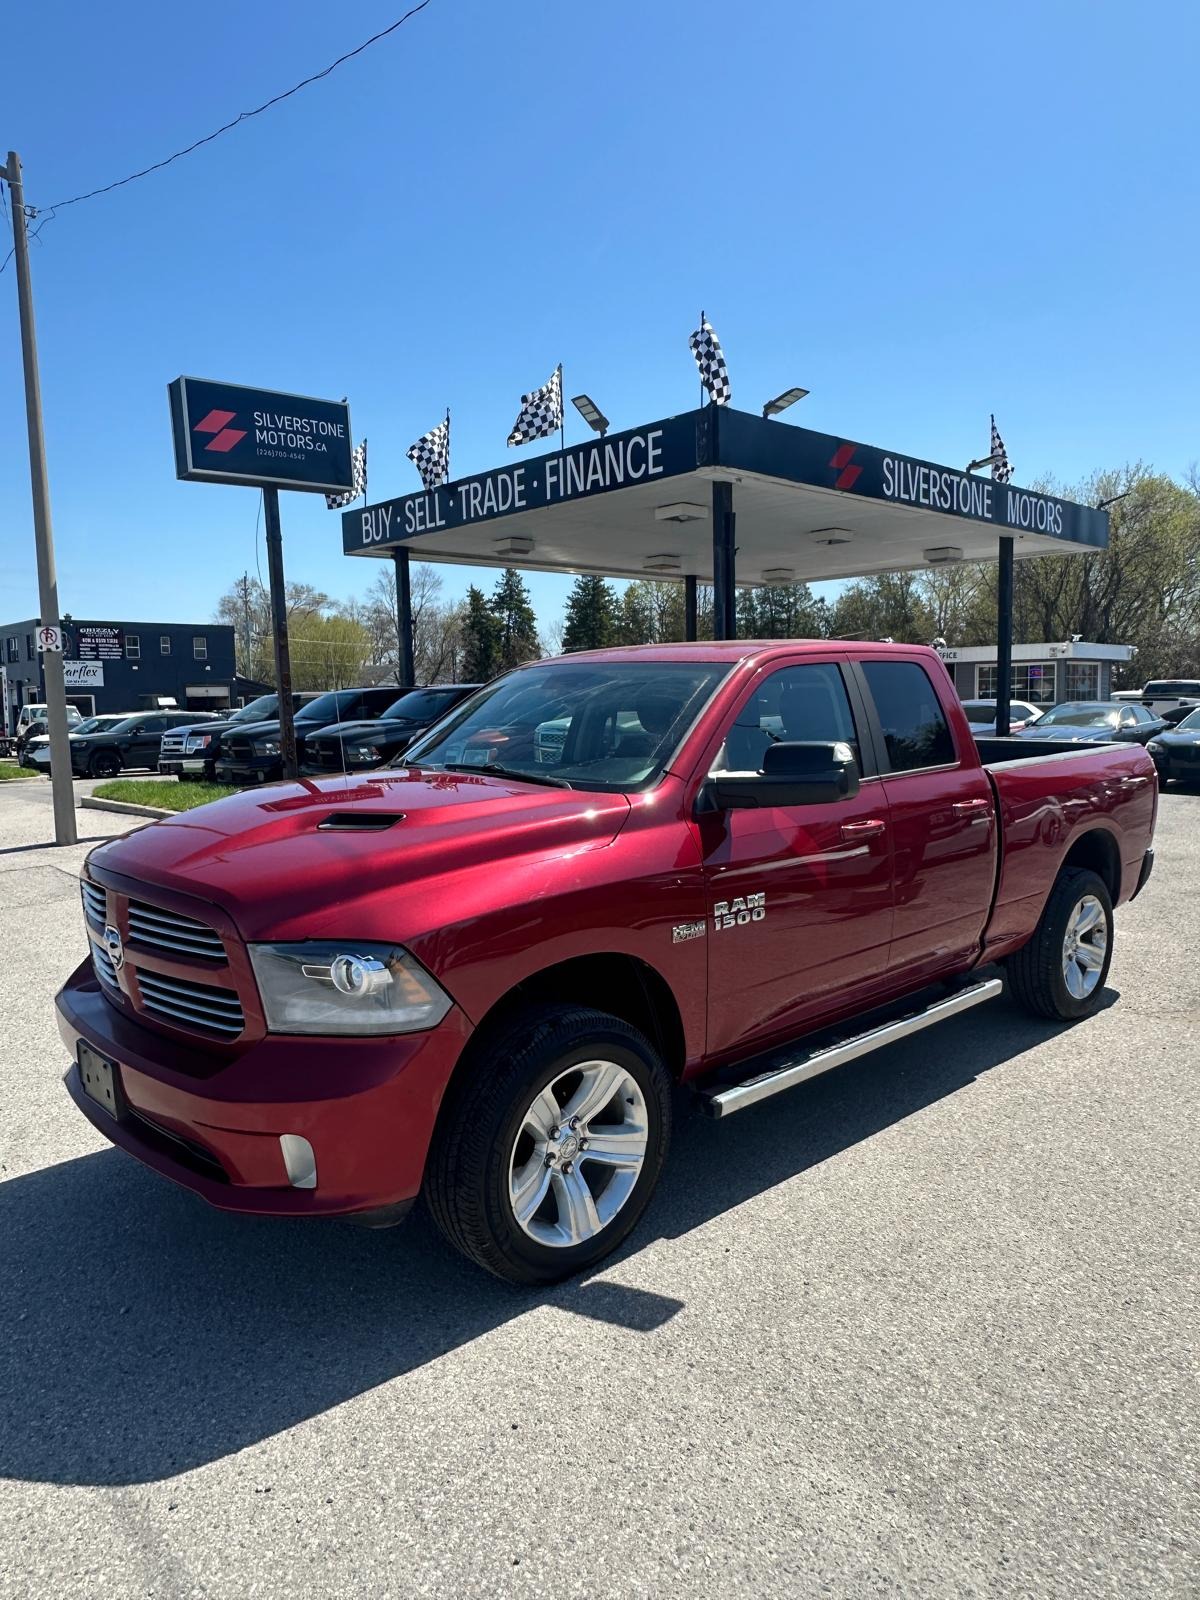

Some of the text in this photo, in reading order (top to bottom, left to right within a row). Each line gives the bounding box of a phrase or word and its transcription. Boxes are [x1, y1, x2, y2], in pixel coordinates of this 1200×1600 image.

[253, 411, 345, 438] SILVERSTONE
[362, 429, 664, 544] BUY SELL TRADE FINANCE
[882, 457, 1063, 535] SILVERSTONE MOTORS
[939, 651, 957, 659] FFICE
[63, 665, 97, 680] arflex
[714, 892, 765, 917] RAM
[715, 907, 766, 931] 1500
